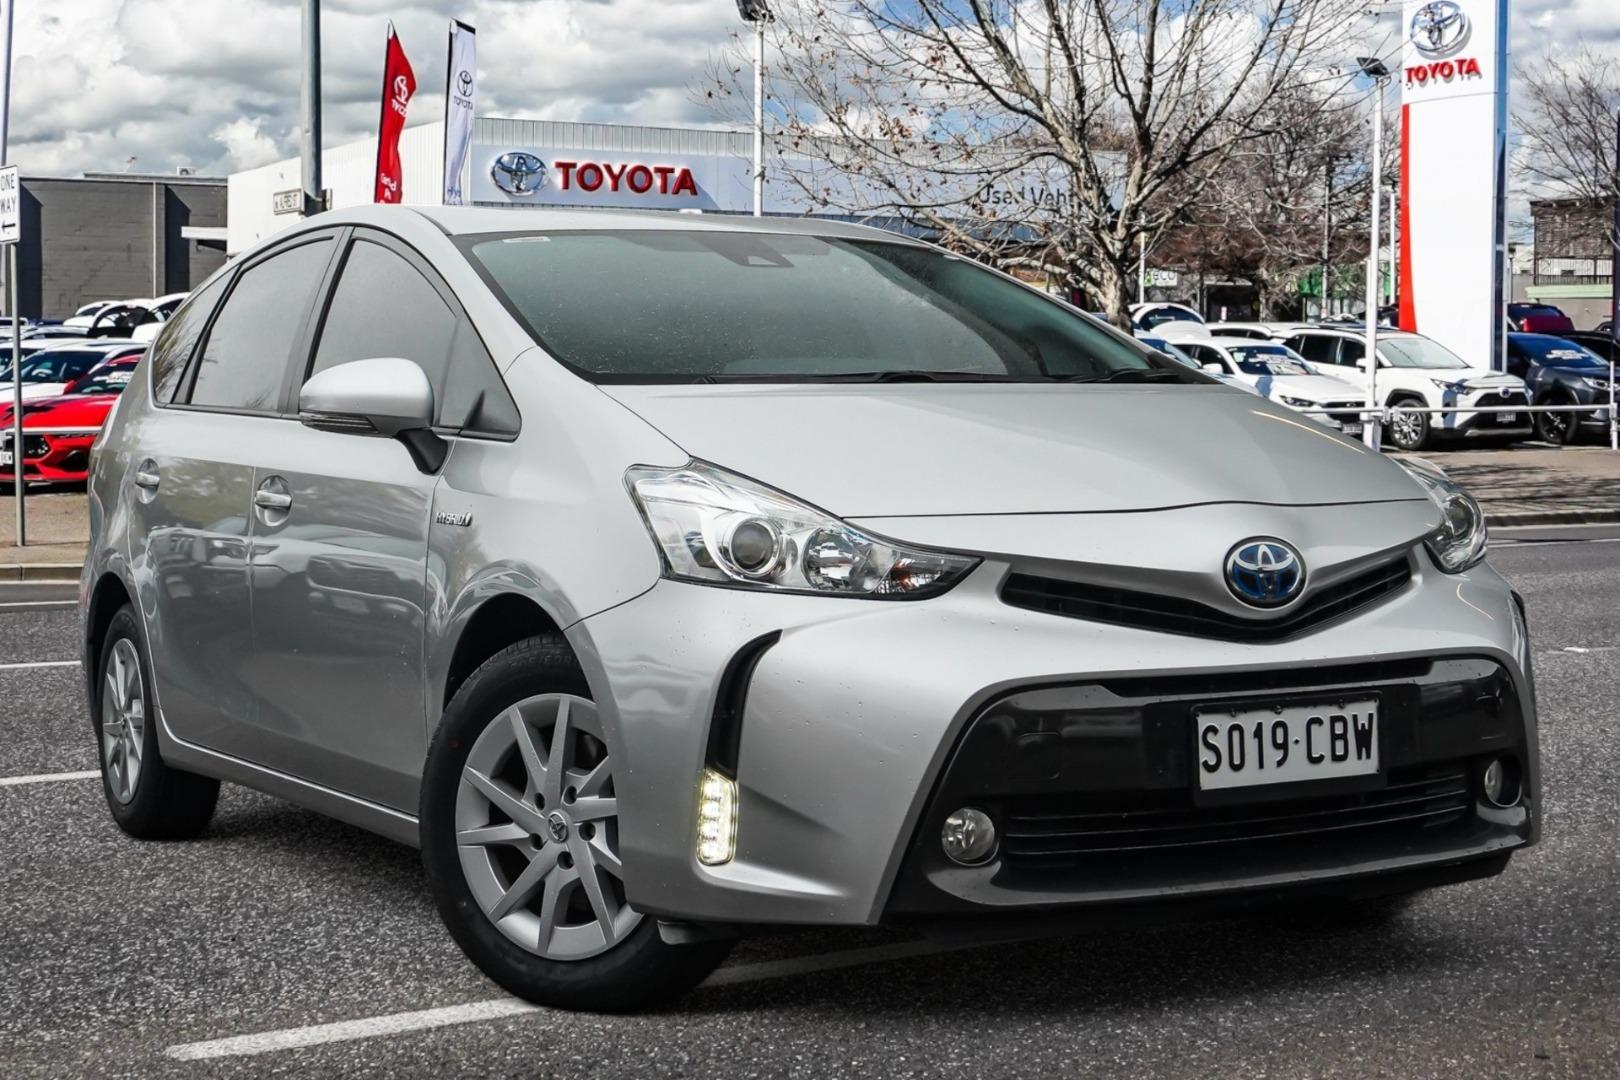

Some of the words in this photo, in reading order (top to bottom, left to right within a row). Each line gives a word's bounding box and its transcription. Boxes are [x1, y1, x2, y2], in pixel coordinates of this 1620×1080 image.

[1404, 58, 1480, 82] TOYOTA
[1, 173, 15, 191] ONE
[555, 161, 698, 196] TOYOTA
[0, 196, 16, 213] WAY
